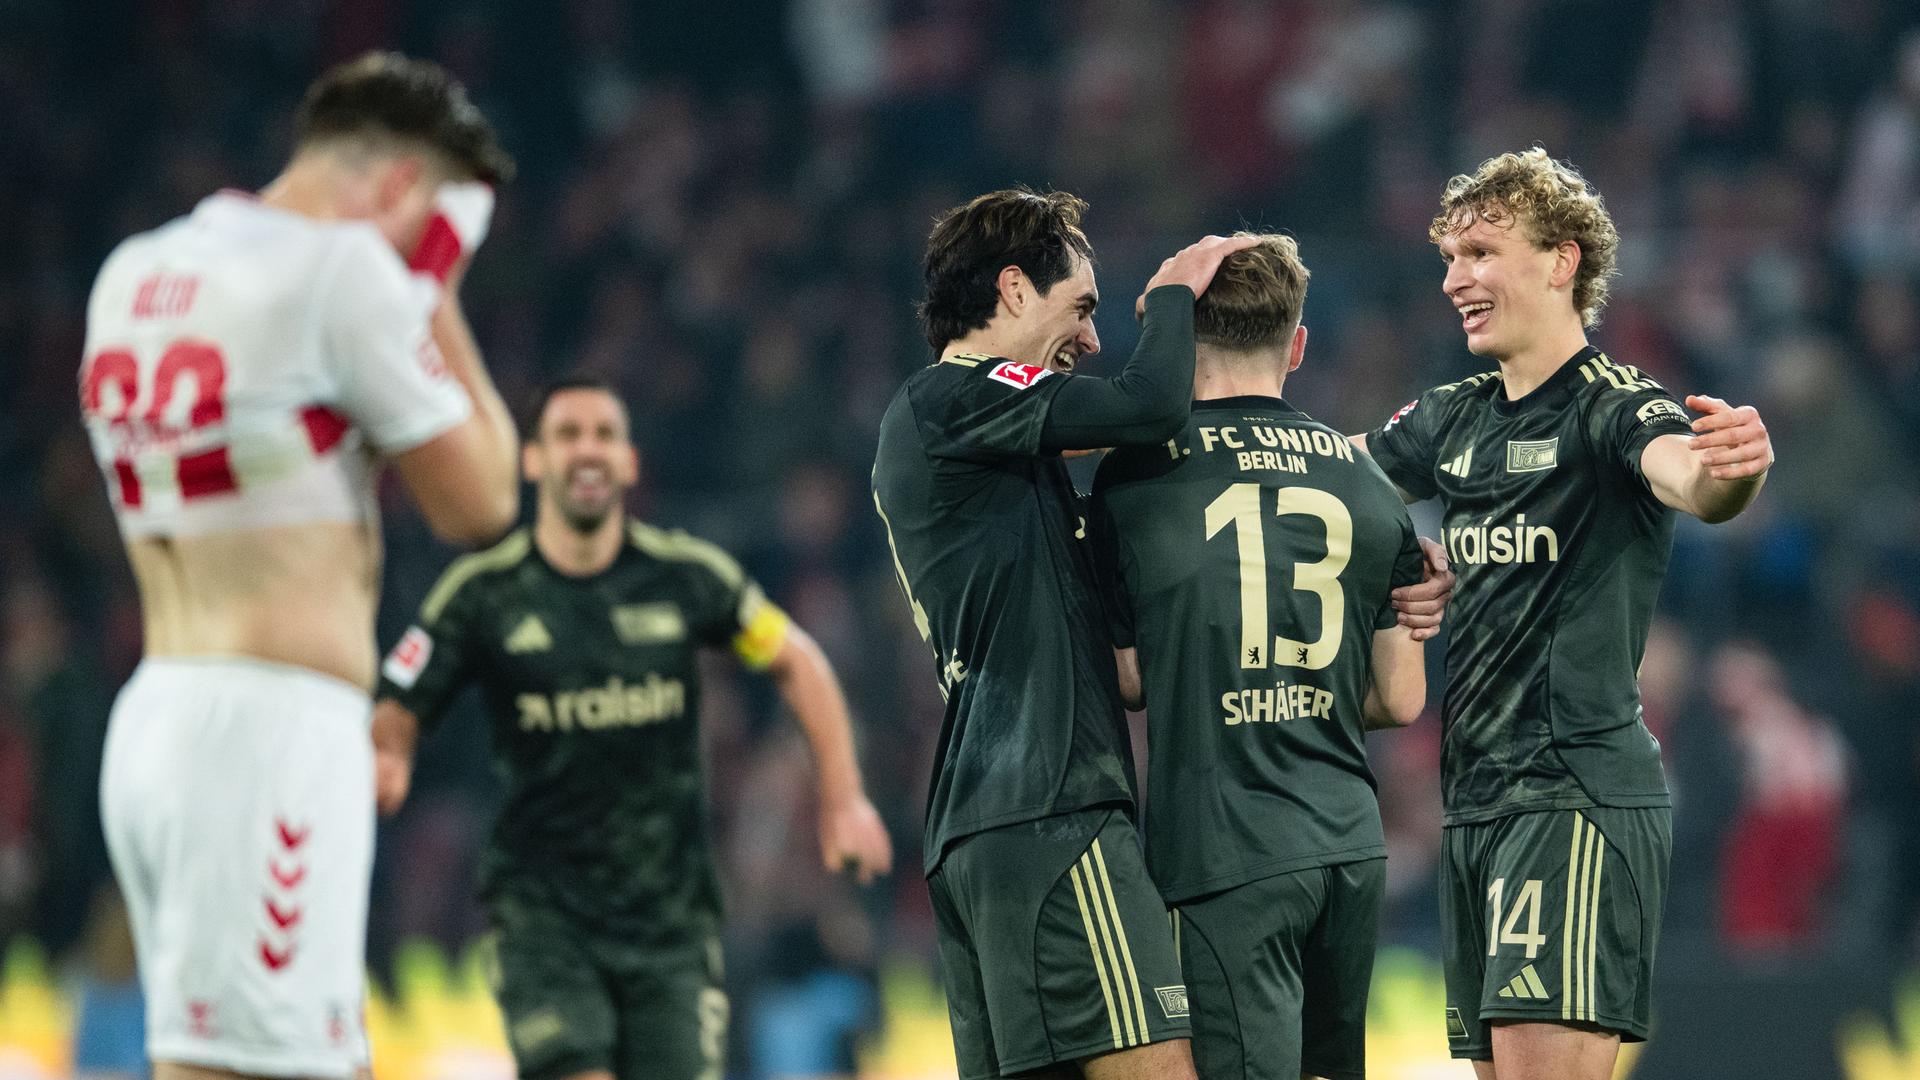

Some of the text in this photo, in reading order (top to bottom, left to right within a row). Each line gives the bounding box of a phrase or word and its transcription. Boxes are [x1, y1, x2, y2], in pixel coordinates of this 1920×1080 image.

[1199, 426, 1245, 452] FC
[1252, 425, 1355, 464] UNION
[1236, 450, 1308, 474] BERLIN
[1204, 482, 1353, 671] 13
[1221, 681, 1334, 725] SCHÄFER
[1486, 877, 1547, 959] 14
